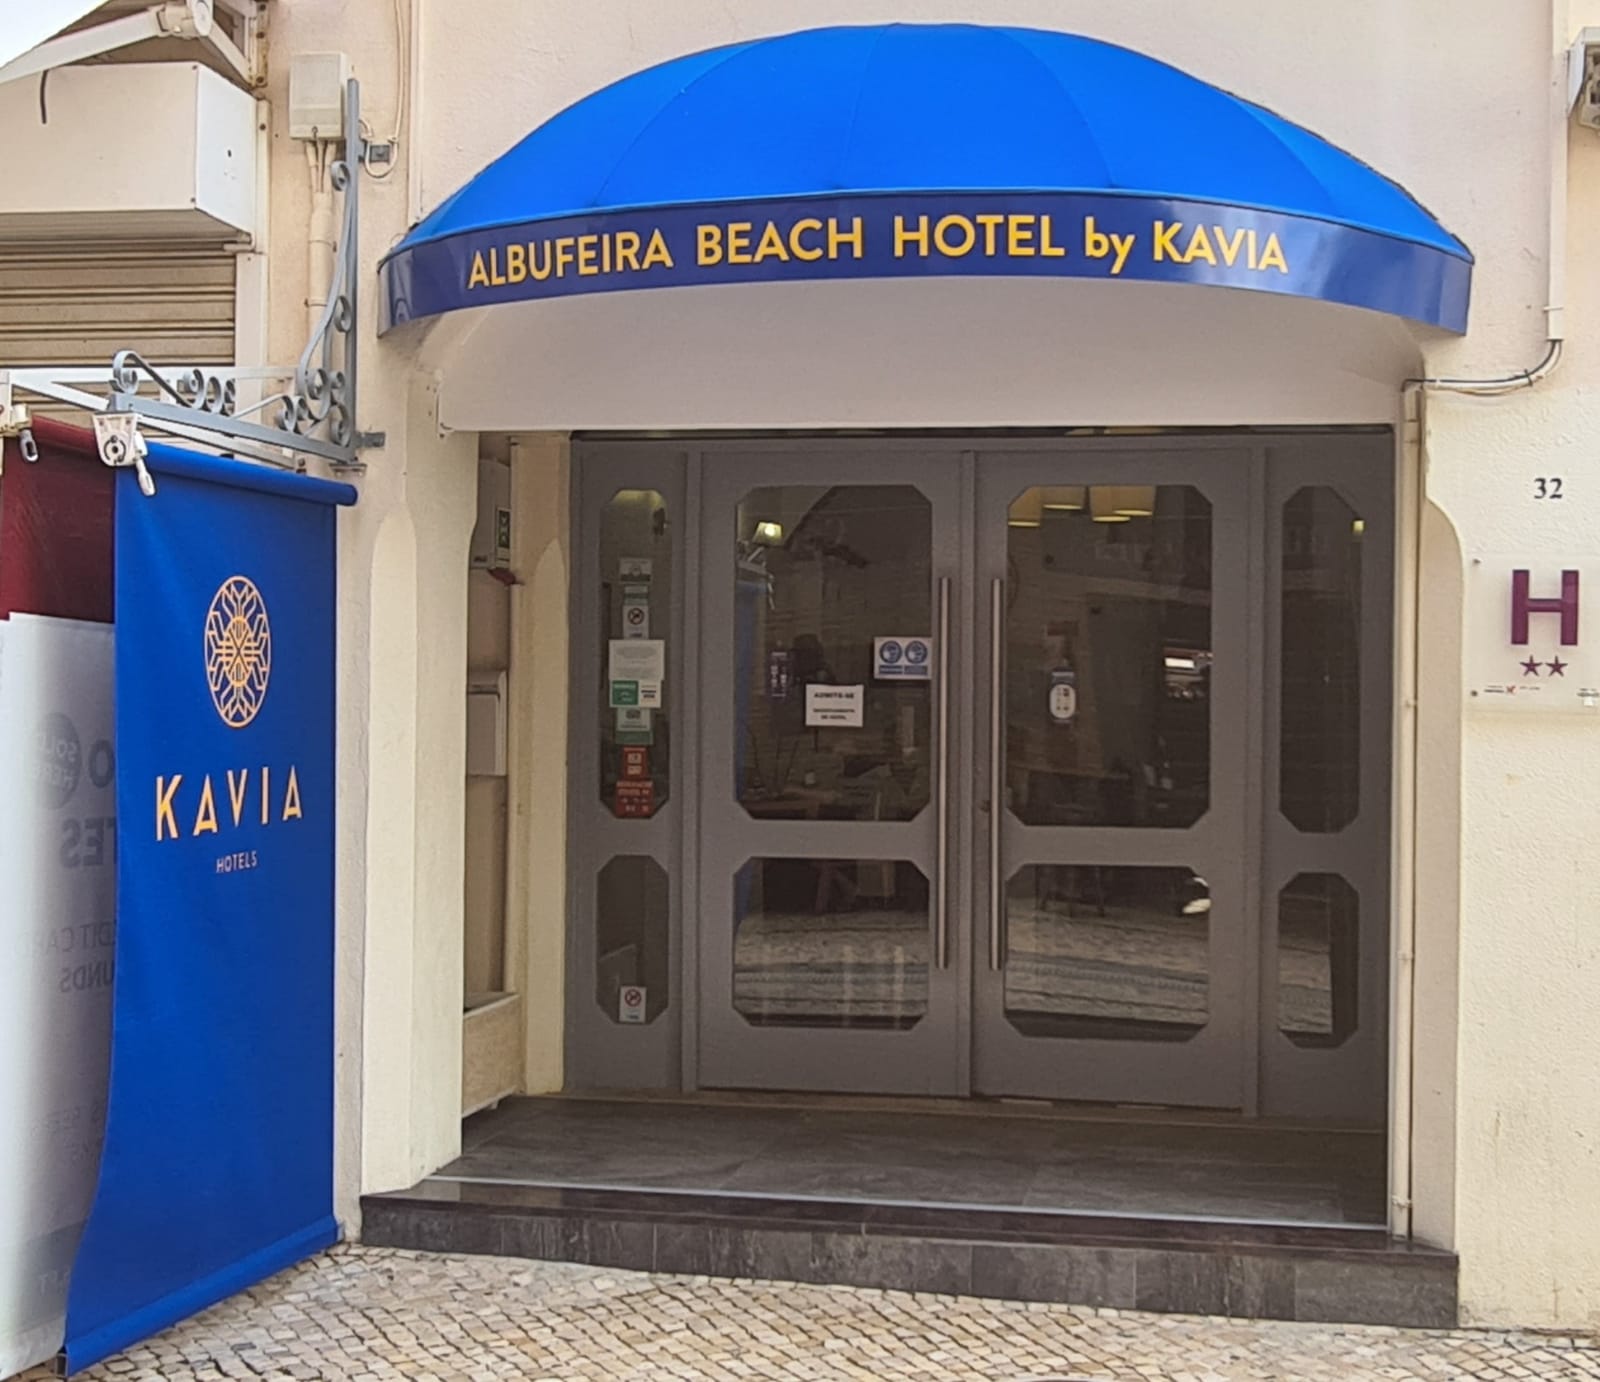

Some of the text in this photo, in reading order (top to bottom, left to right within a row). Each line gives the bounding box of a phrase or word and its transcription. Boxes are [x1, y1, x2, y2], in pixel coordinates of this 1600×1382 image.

[467, 213, 1289, 289] ALBUFEIRA BEACH HOTEL by KAVIA
[1534, 477, 1563, 499] 32
[1511, 569, 1579, 646] H
[155, 764, 303, 842] KAVIA
[215, 850, 258, 874] HOTELS
